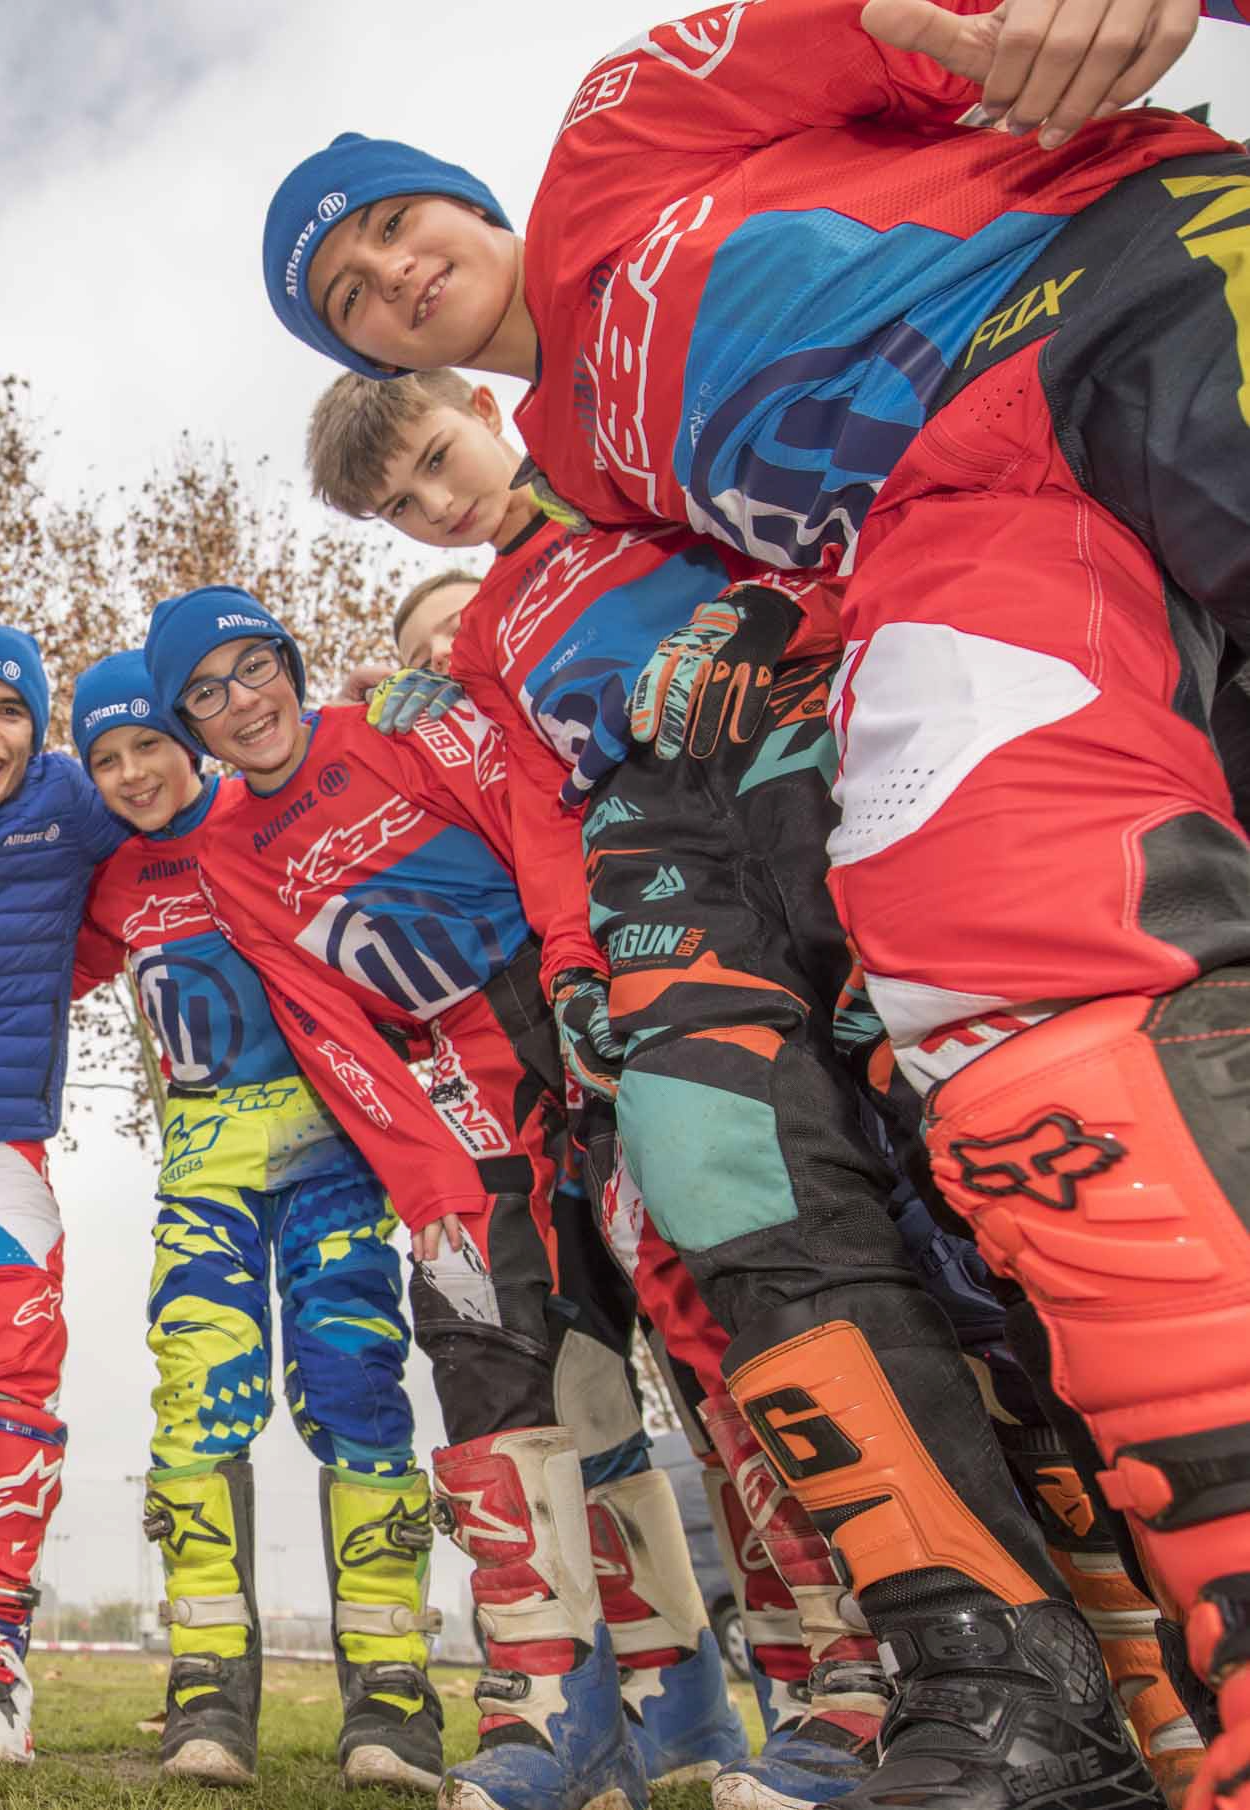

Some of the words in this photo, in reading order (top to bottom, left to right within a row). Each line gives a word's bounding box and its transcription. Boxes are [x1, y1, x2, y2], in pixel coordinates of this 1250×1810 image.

[285, 219, 319, 299] Allianz
[963, 267, 1087, 369] FOX
[216, 613, 270, 631] Allianz
[83, 702, 129, 729] Allianz
[2, 831, 46, 848] Allianz
[252, 789, 319, 854] Allianz
[442, 1108, 481, 1154] MOTORS
